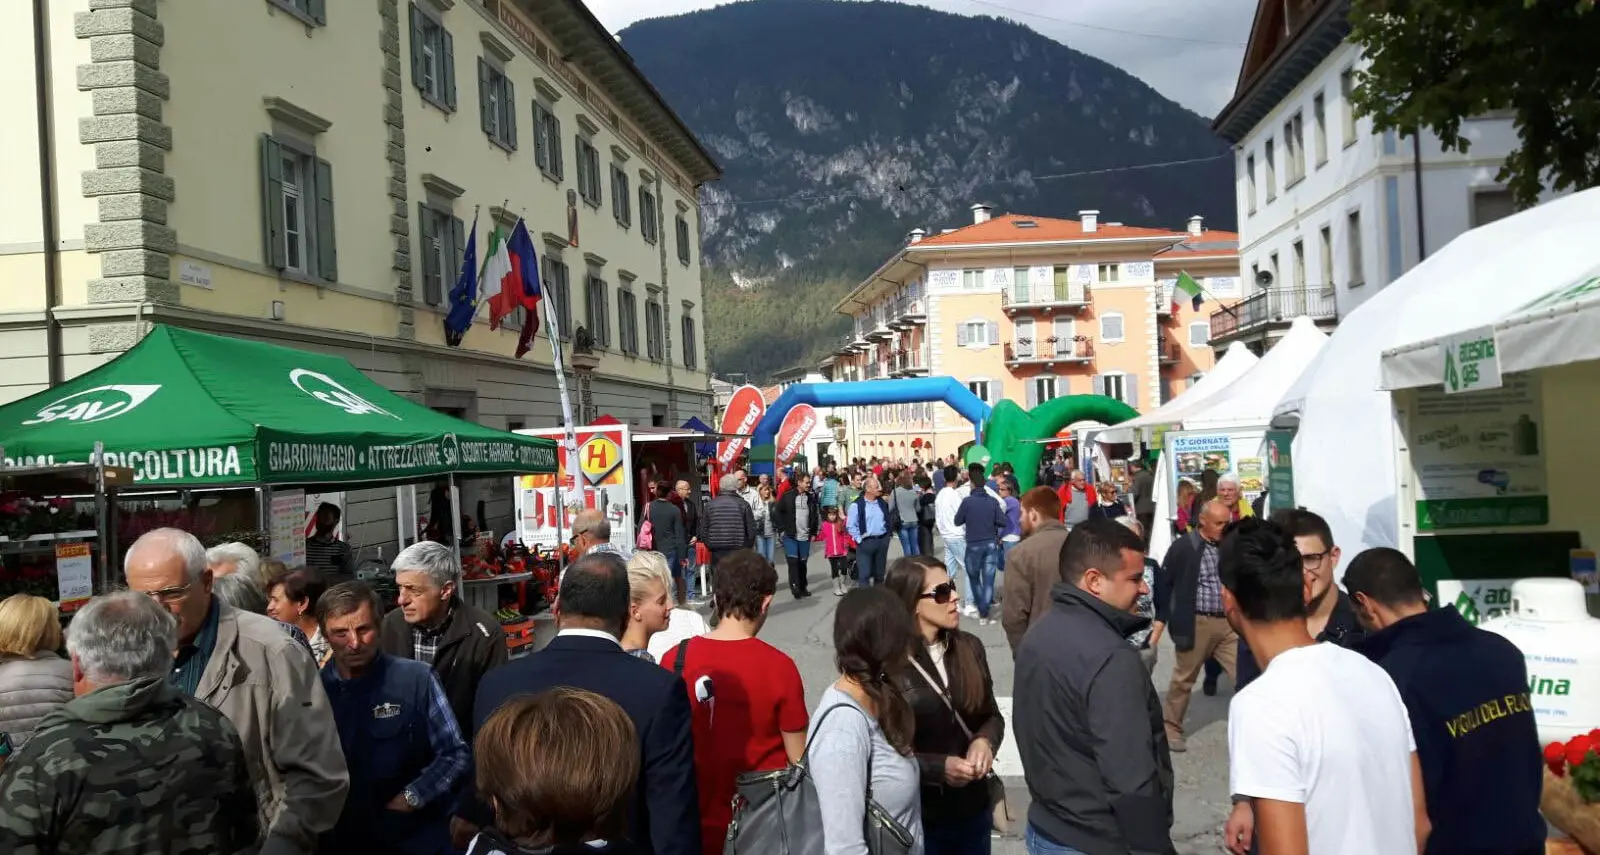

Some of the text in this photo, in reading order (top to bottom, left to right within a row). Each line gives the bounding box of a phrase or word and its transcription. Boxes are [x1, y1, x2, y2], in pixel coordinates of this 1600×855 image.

[1462, 362, 1480, 388] gas
[1188, 437, 1229, 446] GIORNATA
[268, 442, 355, 472] GIARDINAGGIO
[367, 443, 442, 470] ATTREZZATURE
[461, 442, 488, 463] SCORTE
[489, 442, 515, 463] AGRARIE
[588, 443, 607, 469] H
[1480, 699, 1507, 724] DEL
